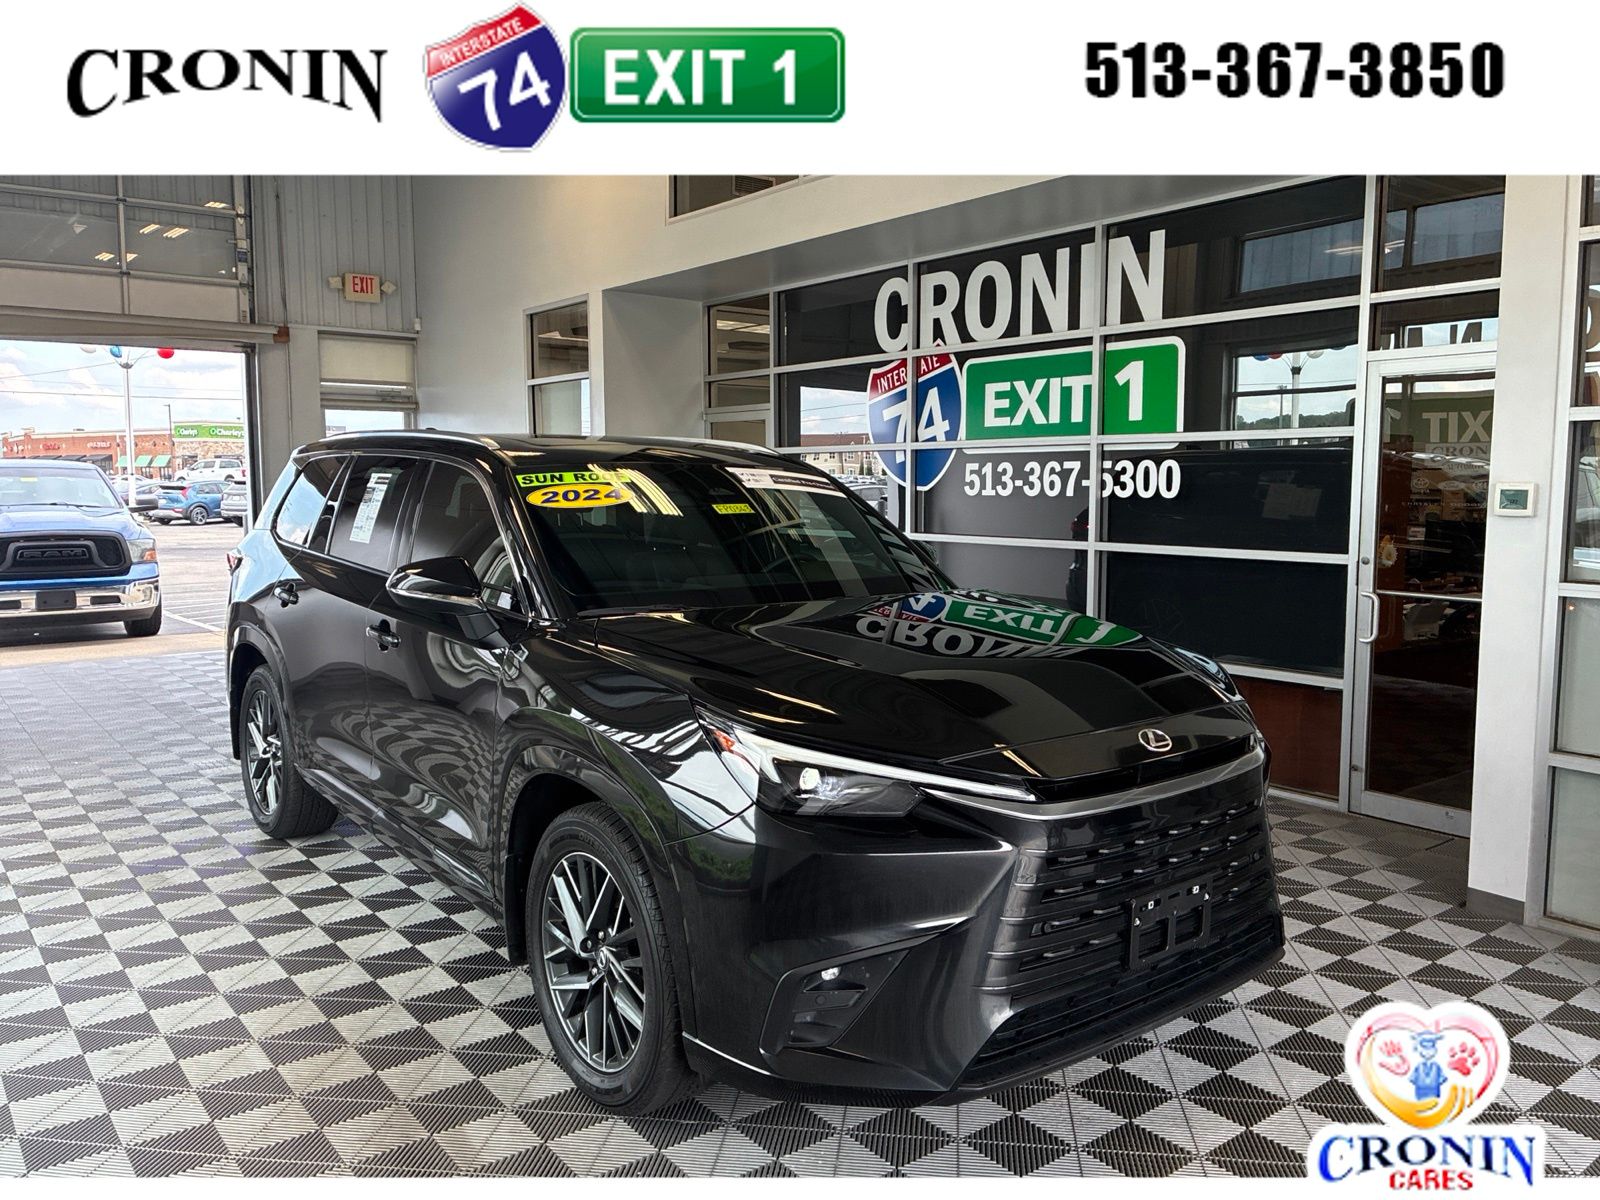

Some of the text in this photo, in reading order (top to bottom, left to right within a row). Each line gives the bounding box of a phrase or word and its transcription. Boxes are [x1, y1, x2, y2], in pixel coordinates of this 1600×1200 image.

[352, 275, 375, 295] EXIT
[874, 229, 1166, 353] CRONIN
[876, 355, 941, 394] INTERATE
[984, 360, 1145, 427] EXIT 1
[881, 386, 950, 464] 74
[521, 473, 564, 485] SUN
[540, 488, 623, 505] 2024
[963, 458, 1181, 499] 513-367-5300
